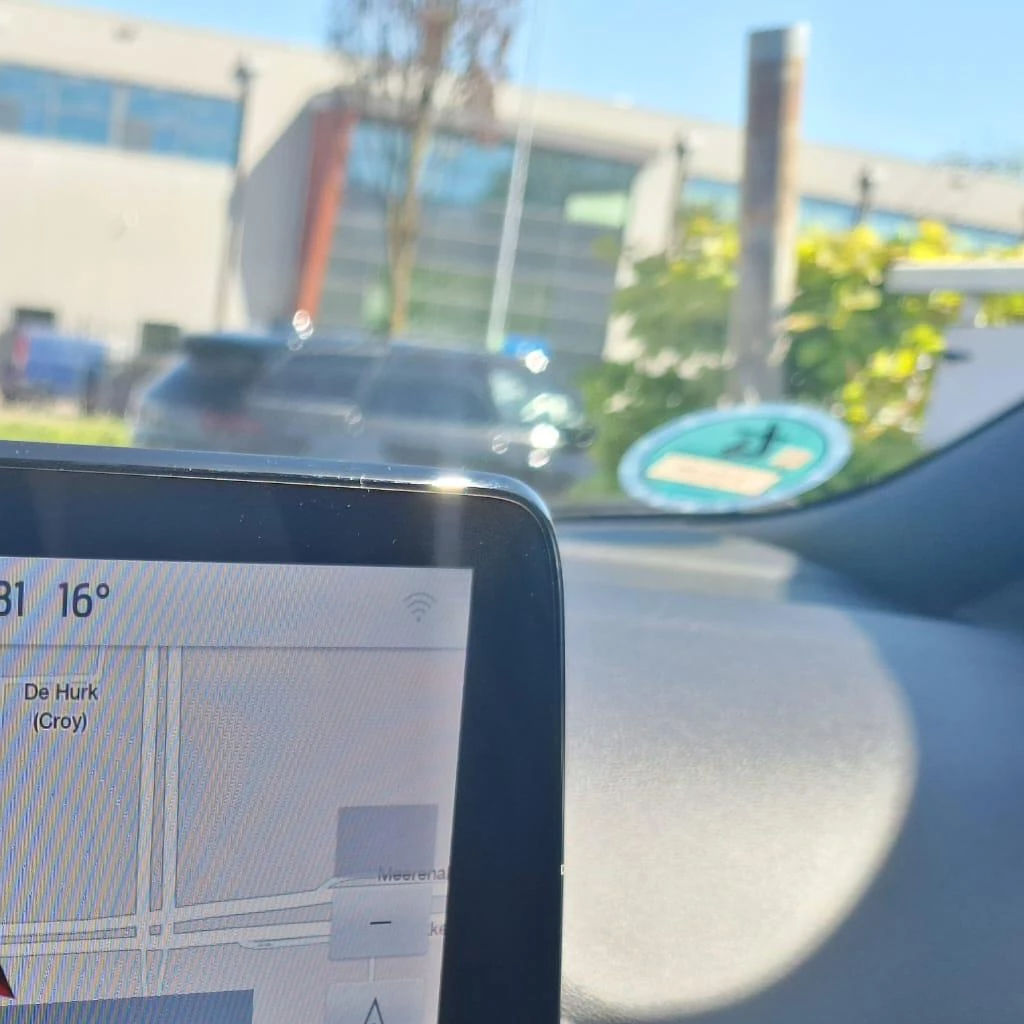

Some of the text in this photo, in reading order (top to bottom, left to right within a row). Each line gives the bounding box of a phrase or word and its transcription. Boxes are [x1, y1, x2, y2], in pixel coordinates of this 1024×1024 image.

[59, 582, 110, 618] 16°
[24, 683, 99, 701] De Hurk
[33, 713, 88, 733] (Croy)
